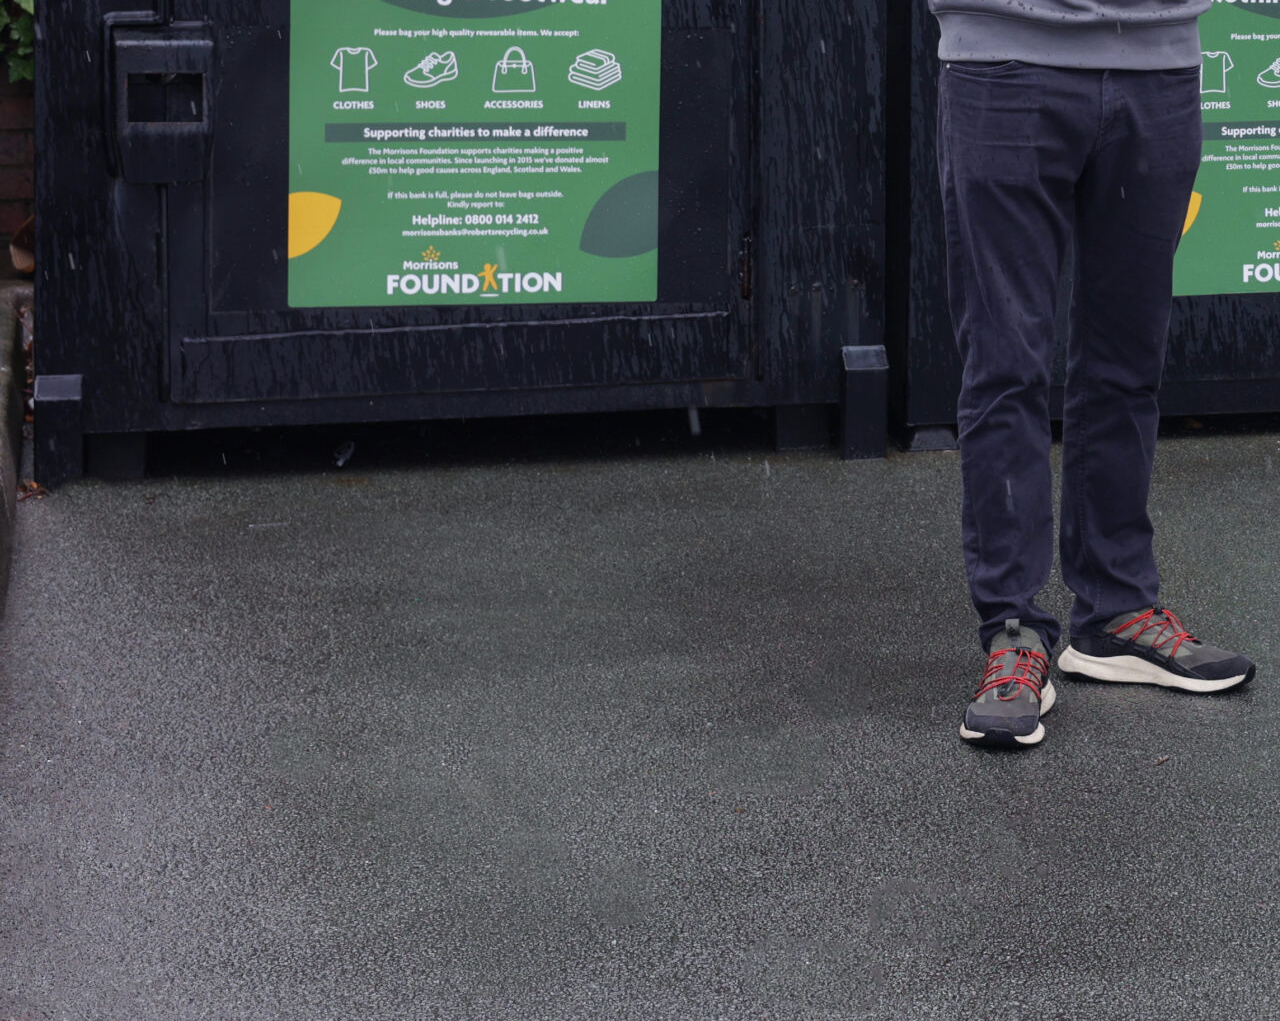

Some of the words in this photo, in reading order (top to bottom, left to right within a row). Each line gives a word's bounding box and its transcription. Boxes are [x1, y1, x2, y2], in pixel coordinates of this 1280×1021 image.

[373, 29, 398, 37] Please
[398, 29, 413, 38] bag
[431, 29, 449, 38] high
[448, 29, 476, 38] quality
[475, 29, 516, 37] rewearable
[516, 29, 539, 37] items.
[553, 30, 580, 38] accept:
[332, 101, 375, 110] CLOTHES
[415, 101, 447, 109] SHOES
[483, 100, 544, 109] ACCESSORIES
[578, 101, 611, 109] LINENS
[1200, 102, 1232, 110] LOTHES
[363, 127, 426, 140] Supporting
[427, 127, 476, 137] charities
[477, 128, 491, 137] to
[492, 126, 522, 136] make
[523, 129, 531, 137] a
[532, 126, 589, 136] difference
[1221, 125, 1277, 137] Supporting
[411, 214, 463, 227] Helpline:
[465, 214, 492, 225] 0800
[495, 214, 513, 225] 014
[516, 213, 539, 224] 2412
[402, 258, 459, 270] Morrisons
